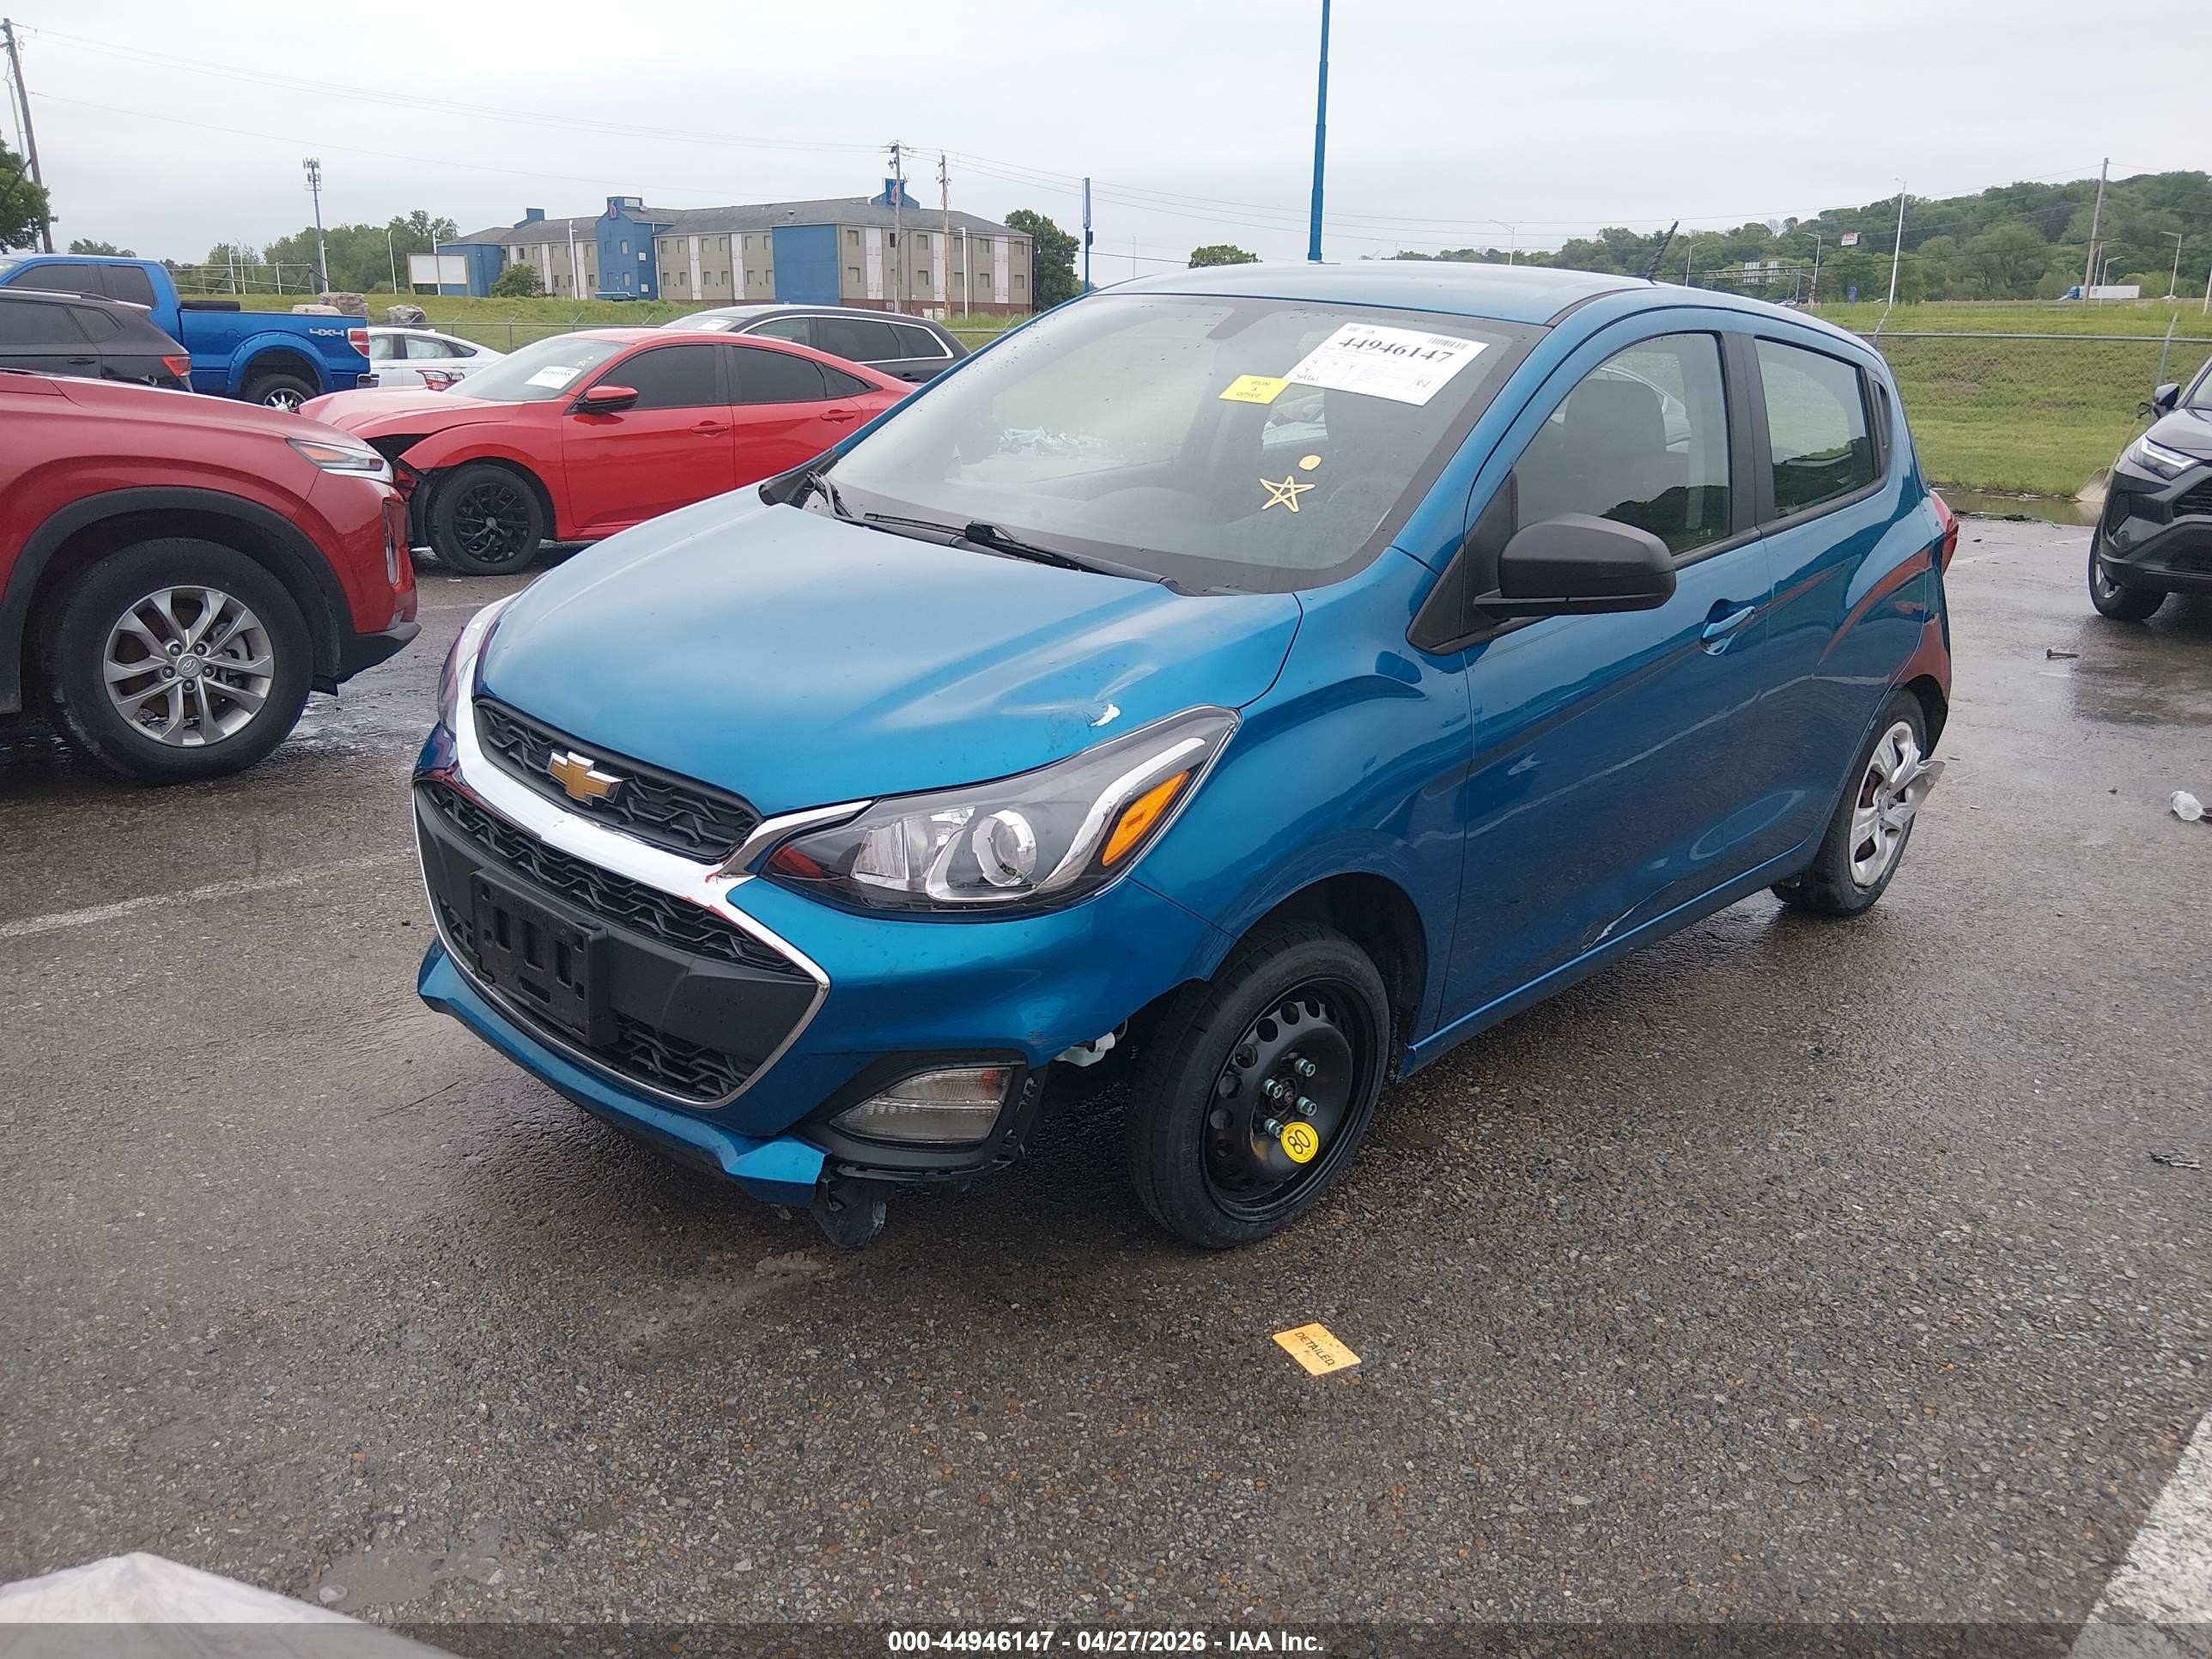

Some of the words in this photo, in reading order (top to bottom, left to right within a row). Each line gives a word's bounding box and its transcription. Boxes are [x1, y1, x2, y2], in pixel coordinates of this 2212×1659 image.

[1339, 337, 1455, 363] 44946147
[1287, 1129, 1310, 1154] 80
[1294, 1332, 1335, 1366] DETAILED
